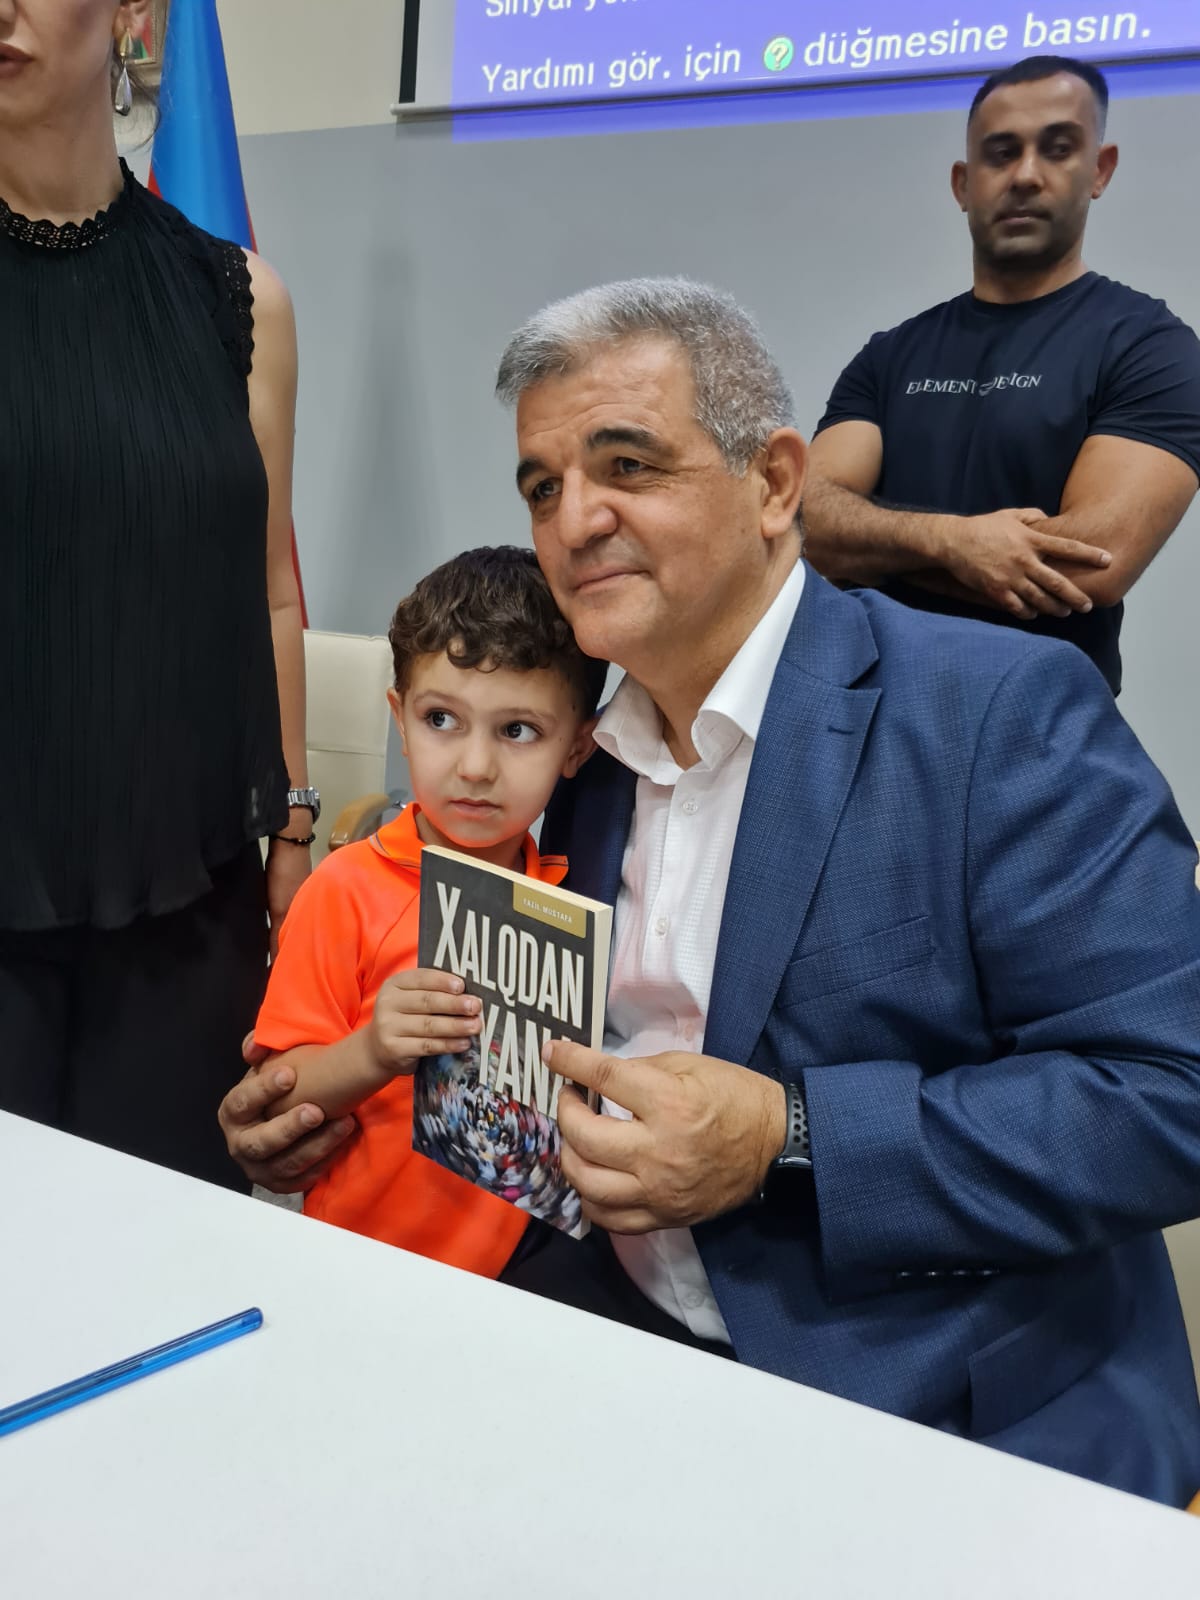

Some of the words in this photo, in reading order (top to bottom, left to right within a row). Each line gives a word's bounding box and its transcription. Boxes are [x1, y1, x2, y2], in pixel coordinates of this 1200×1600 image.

[482, 58, 594, 93] Yardımı
[608, 51, 671, 88] gör.
[684, 42, 741, 81] için
[803, 19, 1008, 69] düğmesine
[1023, 11, 1152, 48] basın.
[433, 881, 584, 1030] XALQDAN
